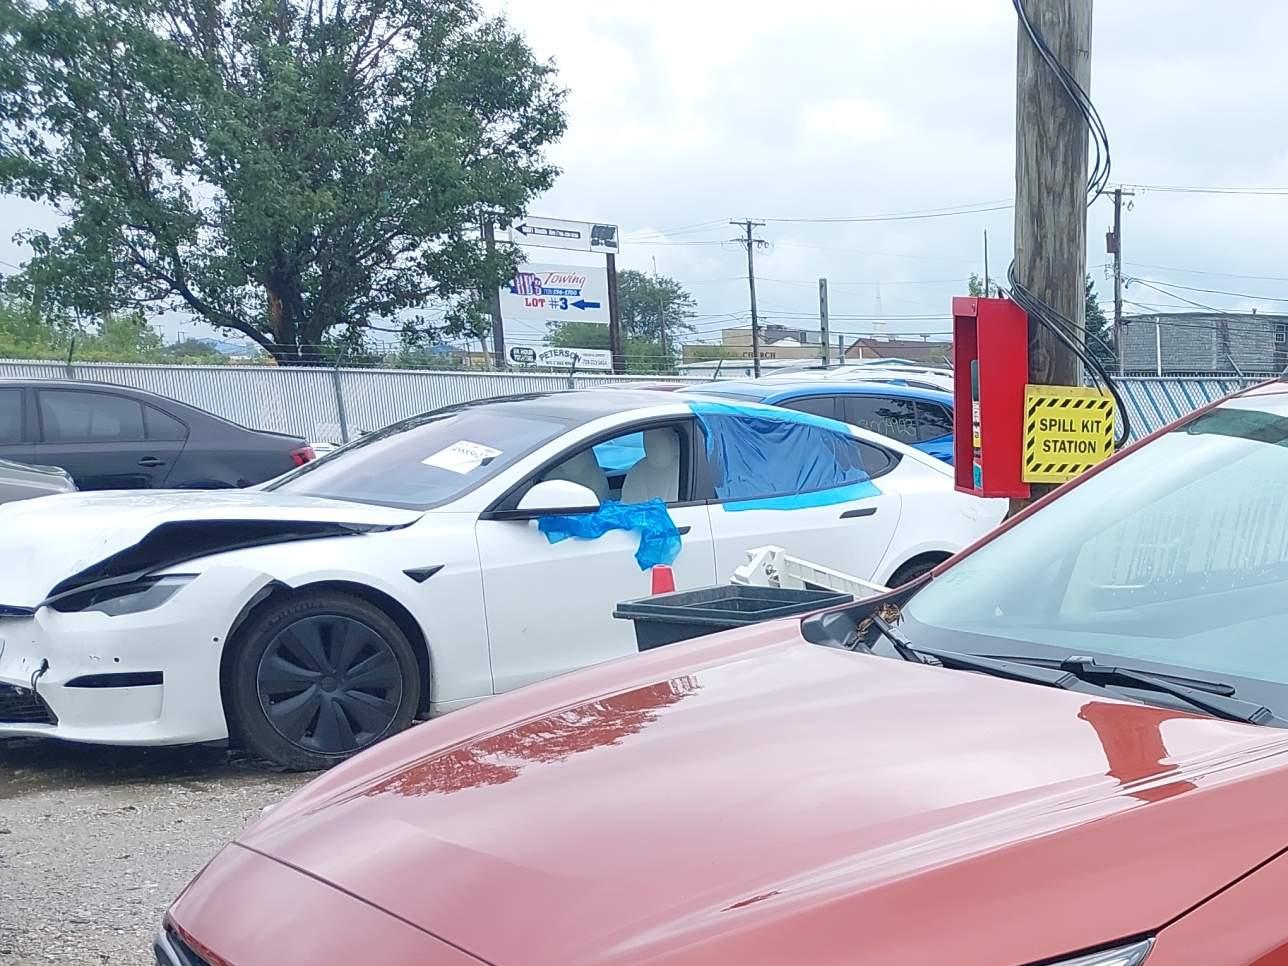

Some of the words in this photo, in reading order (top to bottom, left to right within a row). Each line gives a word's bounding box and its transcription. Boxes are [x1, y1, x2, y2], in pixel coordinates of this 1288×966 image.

[541, 272, 586, 288] Towing
[525, 298, 546, 308] LOT
[548, 297, 569, 311] #3
[1039, 418, 1076, 433] SPILL
[1081, 420, 1102, 433] KIT
[1042, 439, 1097, 453] STATION
